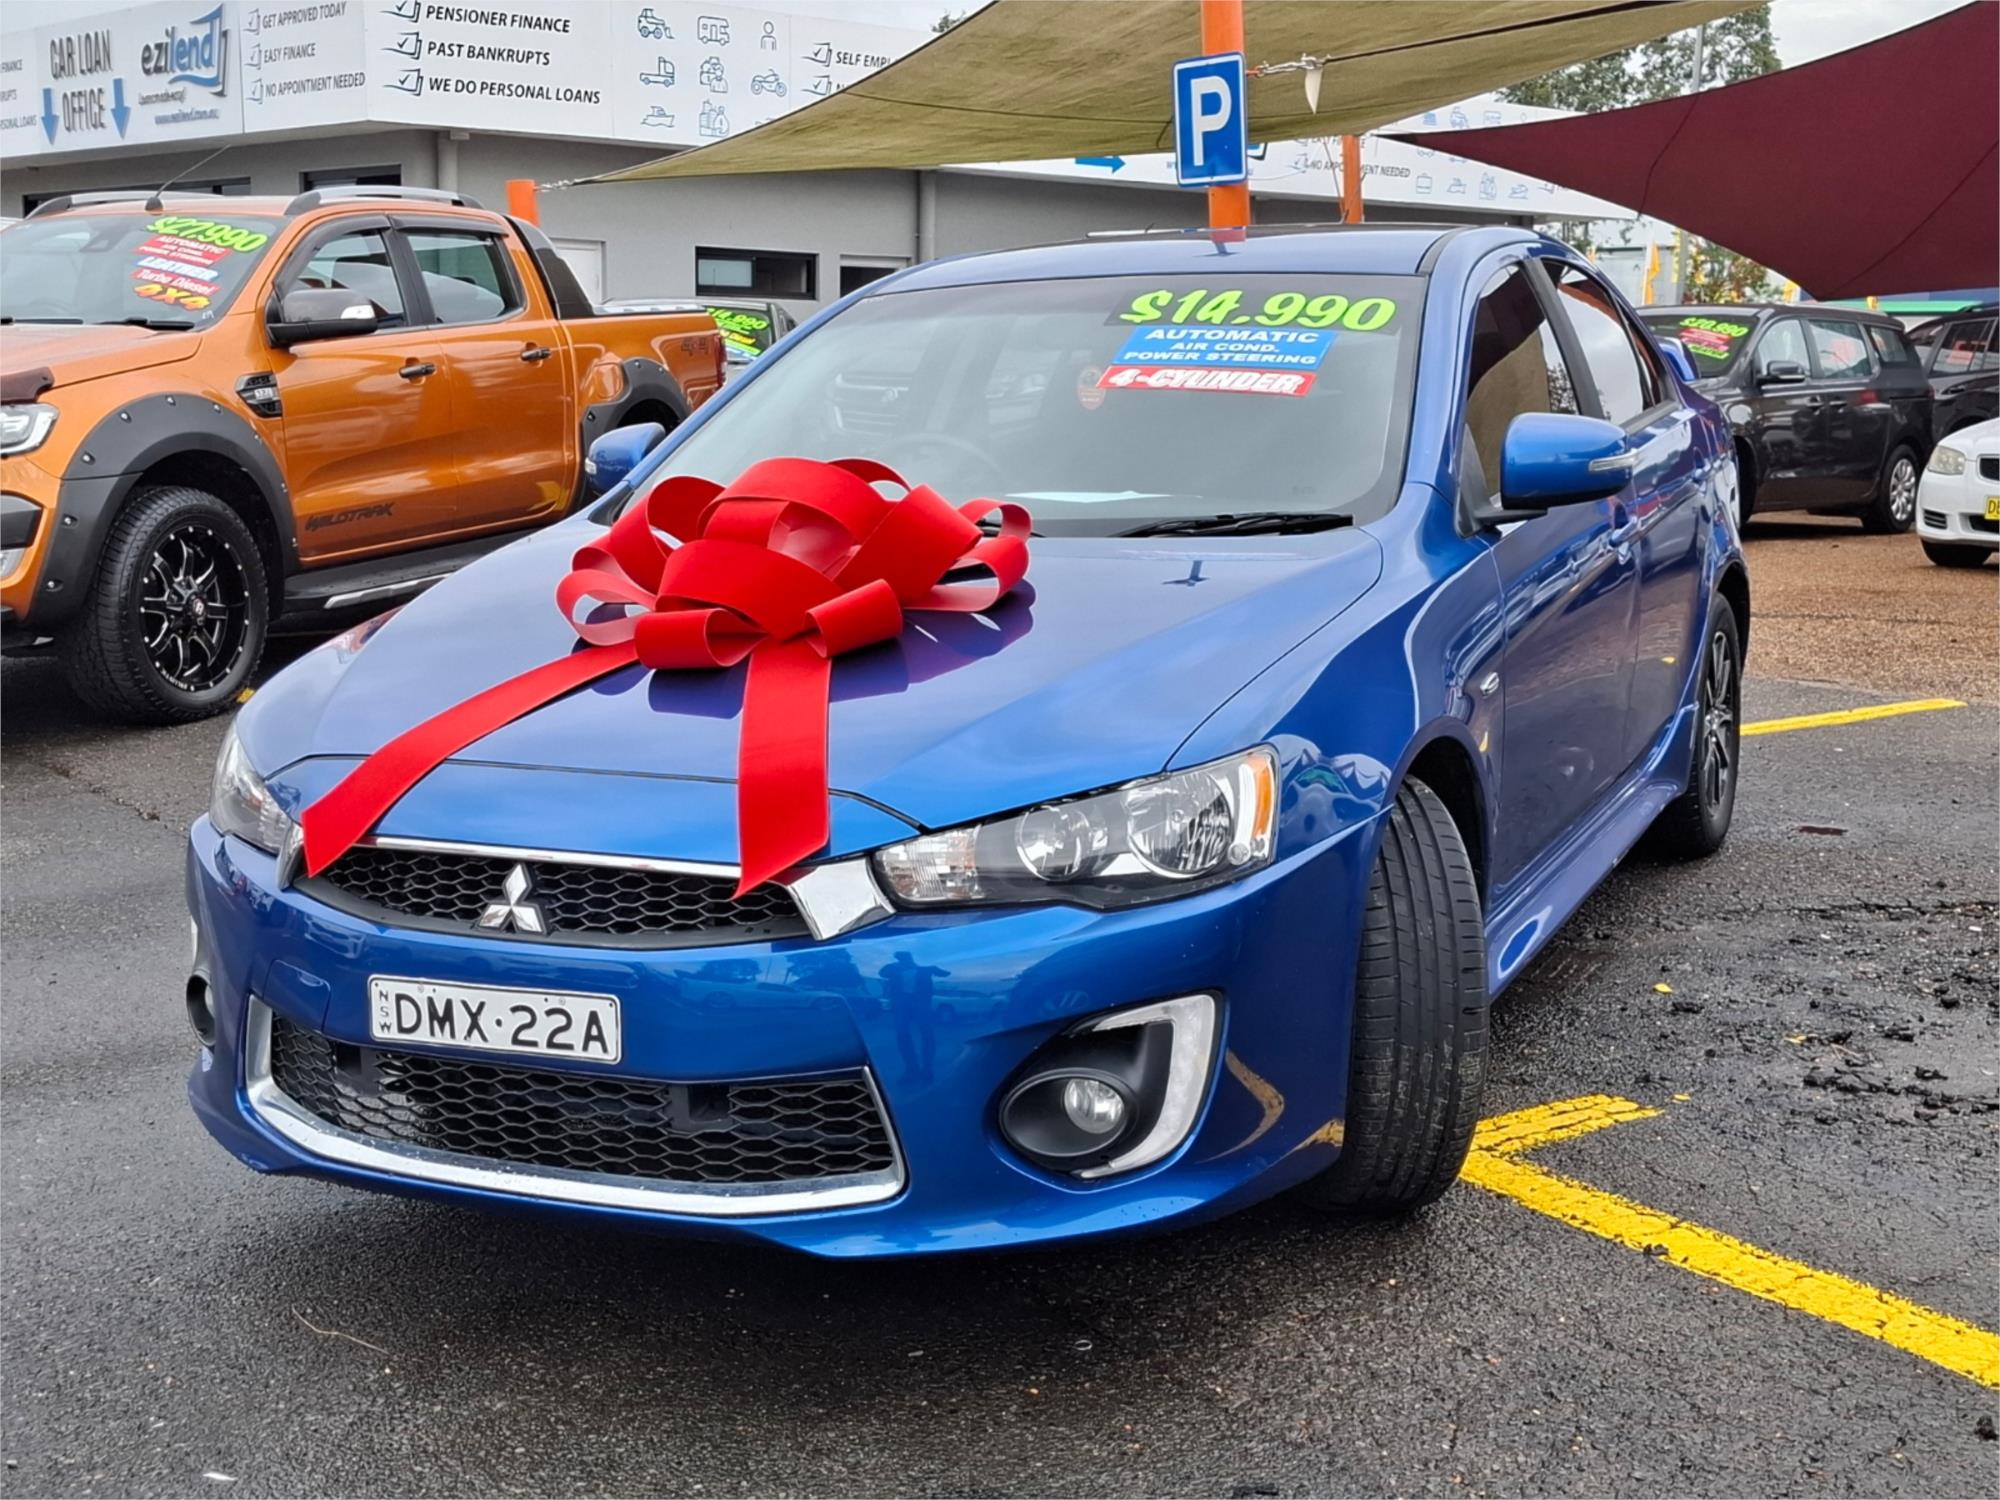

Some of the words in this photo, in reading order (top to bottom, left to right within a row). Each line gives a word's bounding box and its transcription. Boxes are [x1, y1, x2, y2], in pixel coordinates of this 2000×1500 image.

[262, 13, 277, 29] GET
[277, 6, 319, 26] APPROVED
[320, 1, 347, 20] TODAY
[426, 5, 508, 27] PENSIONER
[510, 14, 571, 33] FINANCE
[50, 36, 76, 80] CAR
[78, 28, 113, 75] LOAN
[141, 20, 215, 77] ezilend
[263, 48, 282, 63] EASY
[283, 42, 316, 60] FINANCE
[427, 41, 464, 58] PAST
[466, 45, 550, 66] BANKRUPTS
[836, 51, 861, 65] SELF
[265, 83, 277, 97] NO
[277, 75, 332, 96] APPOINTMENT
[333, 71, 366, 89] NEEDED
[429, 77, 451, 92] WE
[454, 79, 477, 94] DO
[479, 81, 552, 101] PERSONAL
[555, 88, 601, 104] LOANS
[62, 87, 107, 132] OFFICE
[1191, 76, 1232, 167] P
[1380, 165, 1411, 178] NEEDED
[136, 269, 173, 284] Turbo
[1145, 328, 1319, 344] AUTOMATIC
[1170, 342, 1208, 351] AIR
[1214, 342, 1280, 353] COND.
[1123, 351, 1201, 361] POWER
[1204, 352, 1317, 365] STEERING
[1108, 367, 1306, 394] 4-CYLINDER
